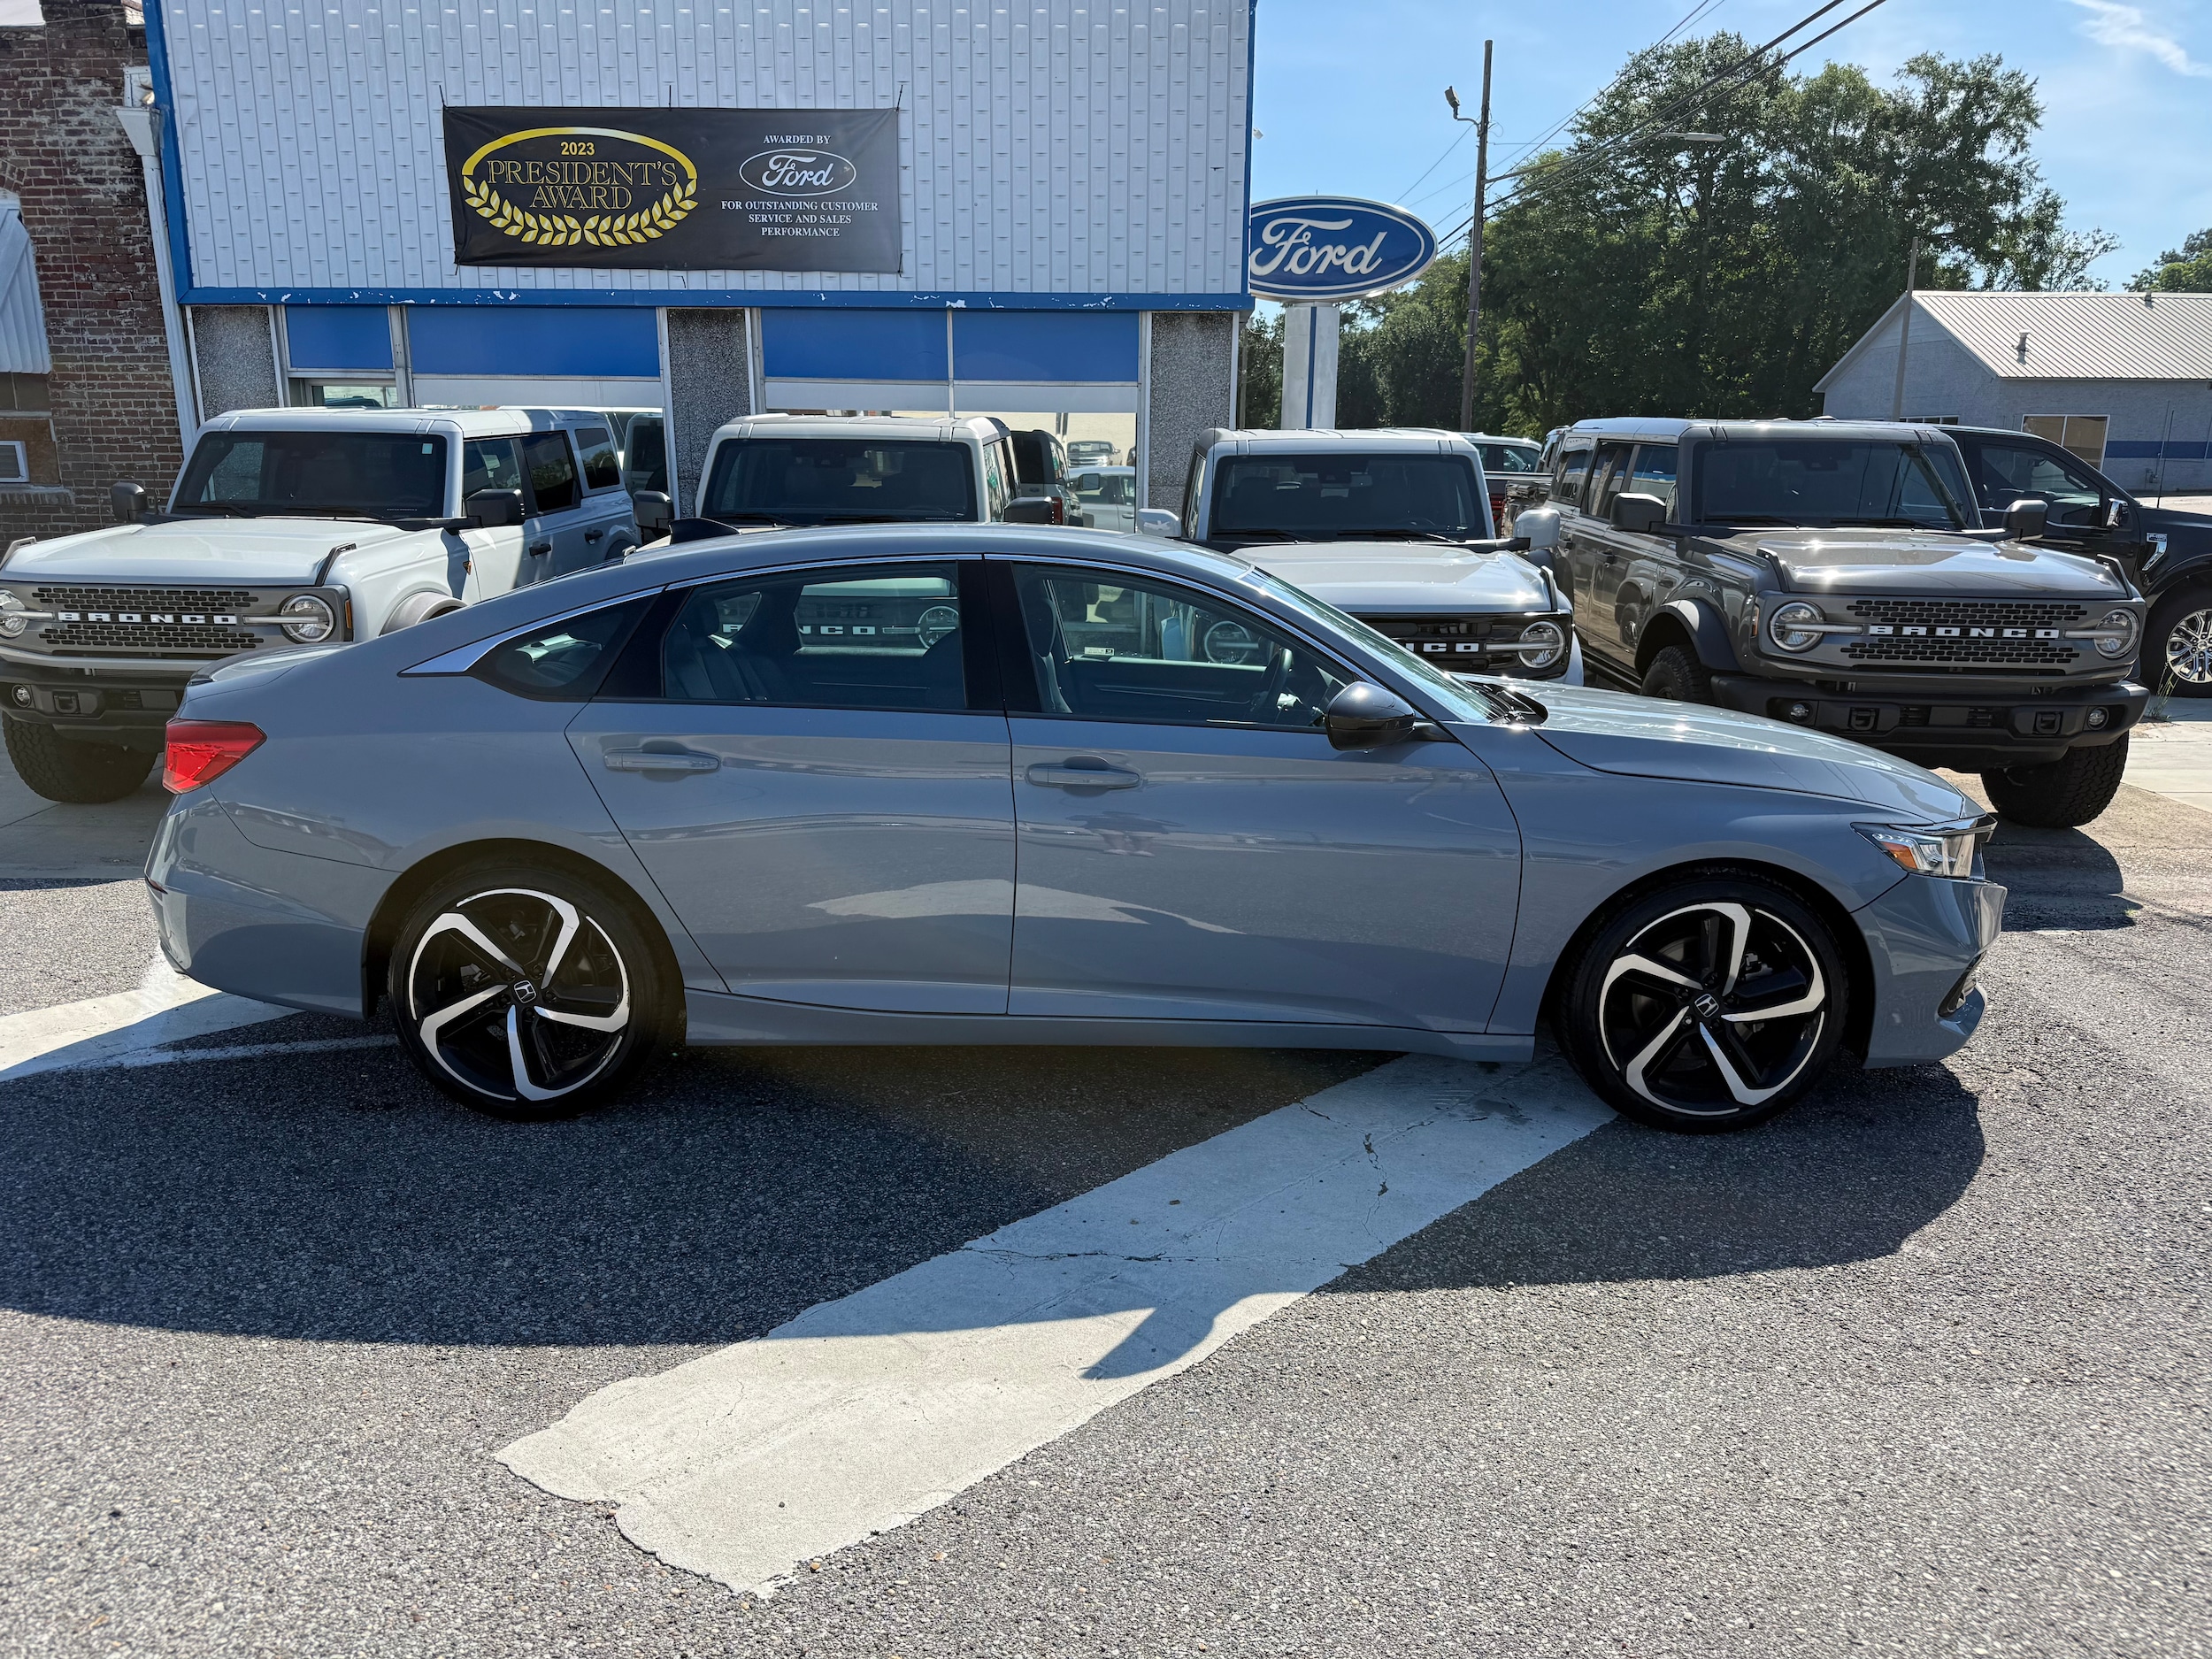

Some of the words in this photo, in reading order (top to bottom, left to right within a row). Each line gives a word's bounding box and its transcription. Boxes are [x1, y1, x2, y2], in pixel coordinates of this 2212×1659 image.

[763, 134, 814, 144] AWARDED
[816, 135, 832, 144] BY
[560, 142, 595, 156] 2023
[487, 160, 678, 186] PRESIDENT'S
[761, 154, 834, 187] Ford
[529, 186, 633, 210] AWARD
[720, 200, 743, 210] FOR
[745, 201, 818, 211] OUTSTANDING
[820, 201, 879, 211] CUSTOMER
[749, 214, 793, 223] SERVICE
[795, 215, 818, 224] AND
[819, 215, 852, 224] SALES
[761, 227, 841, 237] PERFORMANCE
[1250, 218, 1387, 276] Ford
[58, 611, 237, 624] BRONCO
[1868, 625, 2060, 639] BRONCO
